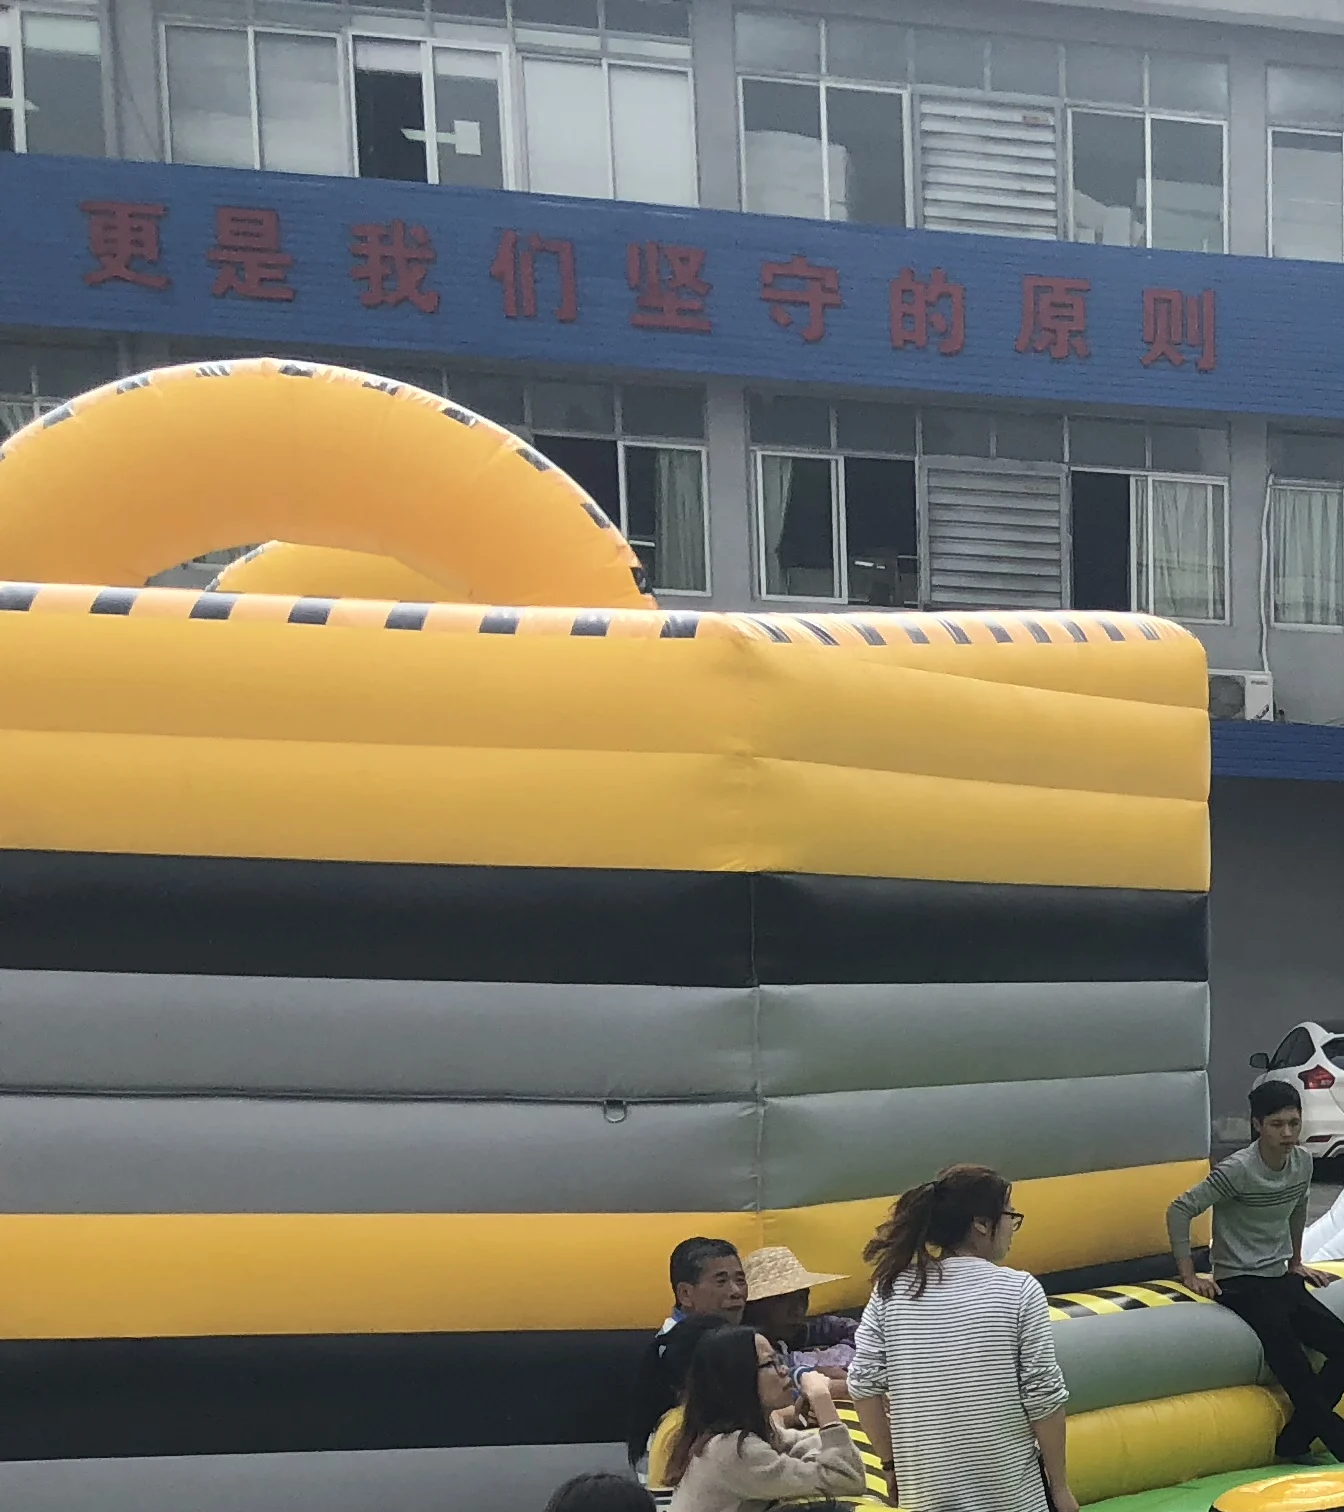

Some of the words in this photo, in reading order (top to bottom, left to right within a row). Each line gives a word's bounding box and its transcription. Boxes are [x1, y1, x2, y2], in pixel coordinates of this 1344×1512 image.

[80, 200, 1217, 372] 更是我们坚守的原则
